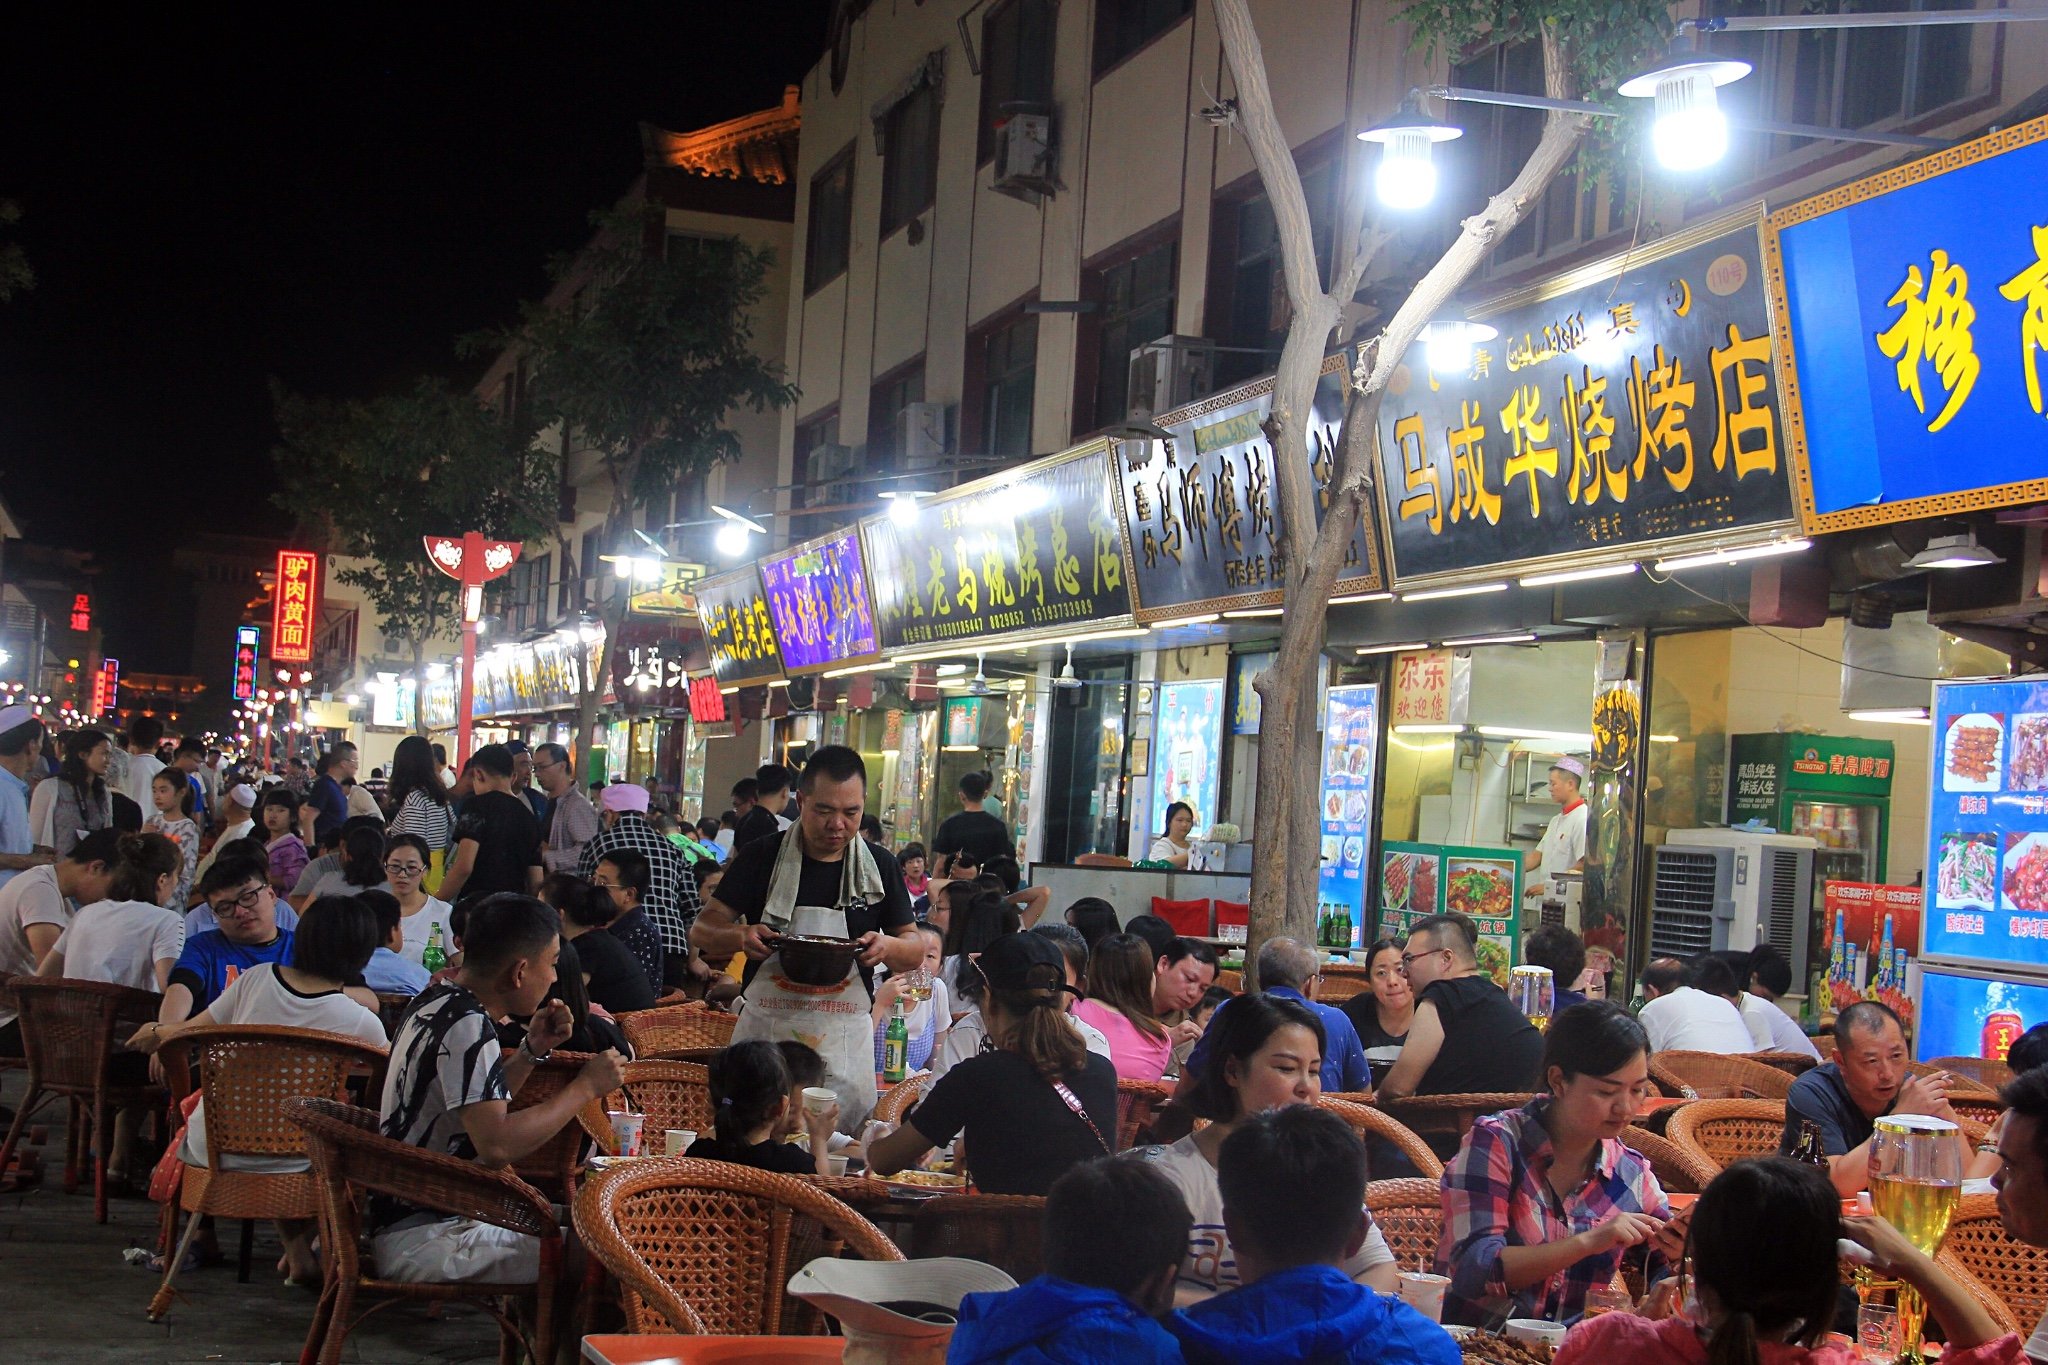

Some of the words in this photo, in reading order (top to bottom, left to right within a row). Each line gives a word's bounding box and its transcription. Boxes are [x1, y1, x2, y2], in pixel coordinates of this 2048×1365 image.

[1709, 260, 1744, 288] 110号
[1604, 302, 1640, 339] 真
[1393, 322, 1777, 537] 马成华烧烤店
[882, 502, 1121, 621] 煌老马烧烤总店
[71, 594, 91, 632] 足道
[281, 557, 309, 647] 驴肉黄面
[989, 612, 1026, 630] 8829852
[1031, 599, 1094, 622] 15193733989
[1399, 652, 1446, 692] 尕东
[1396, 693, 1445, 721] 欢迎您
[1737, 762, 1776, 782] 青岛纯生
[1795, 762, 1825, 772] TSINGTAO
[1829, 754, 1891, 778] 青岛啤酒
[1738, 779, 1775, 795] 鲜活人生
[1474, 919, 1506, 934] 炕锅
